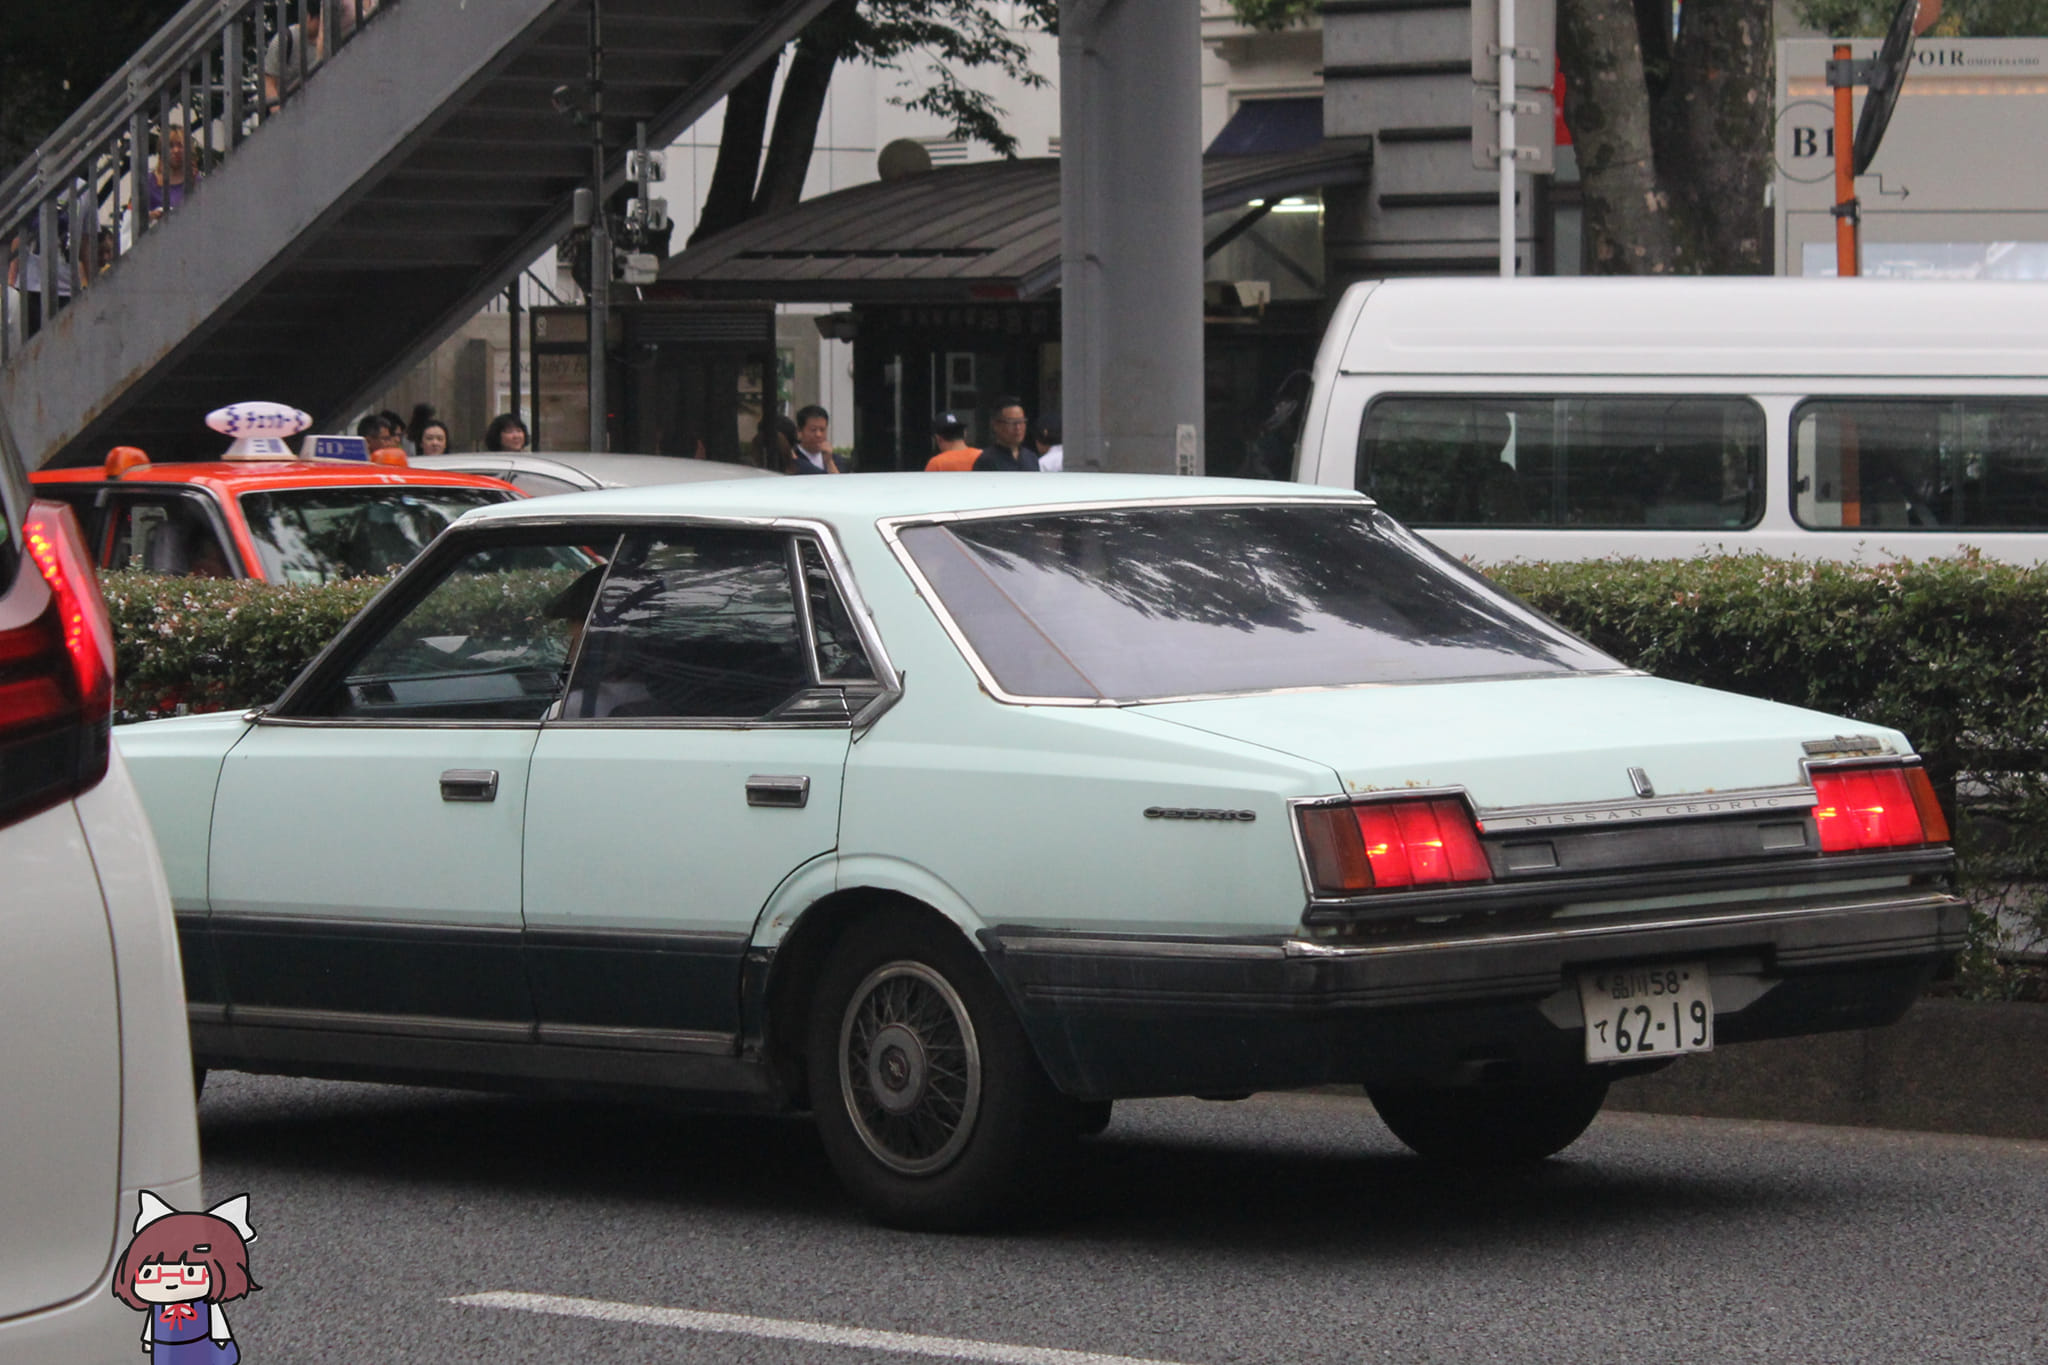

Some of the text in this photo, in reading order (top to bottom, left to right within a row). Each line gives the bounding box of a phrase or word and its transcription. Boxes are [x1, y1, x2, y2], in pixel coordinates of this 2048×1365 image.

[245, 411, 291, 429] チェッカー
[318, 441, 344, 454] iD
[1144, 806, 1256, 821] CEDRIC
[1526, 797, 1780, 827] NISSAN CEDRIC
[1615, 1000, 1707, 1053] 62-19
